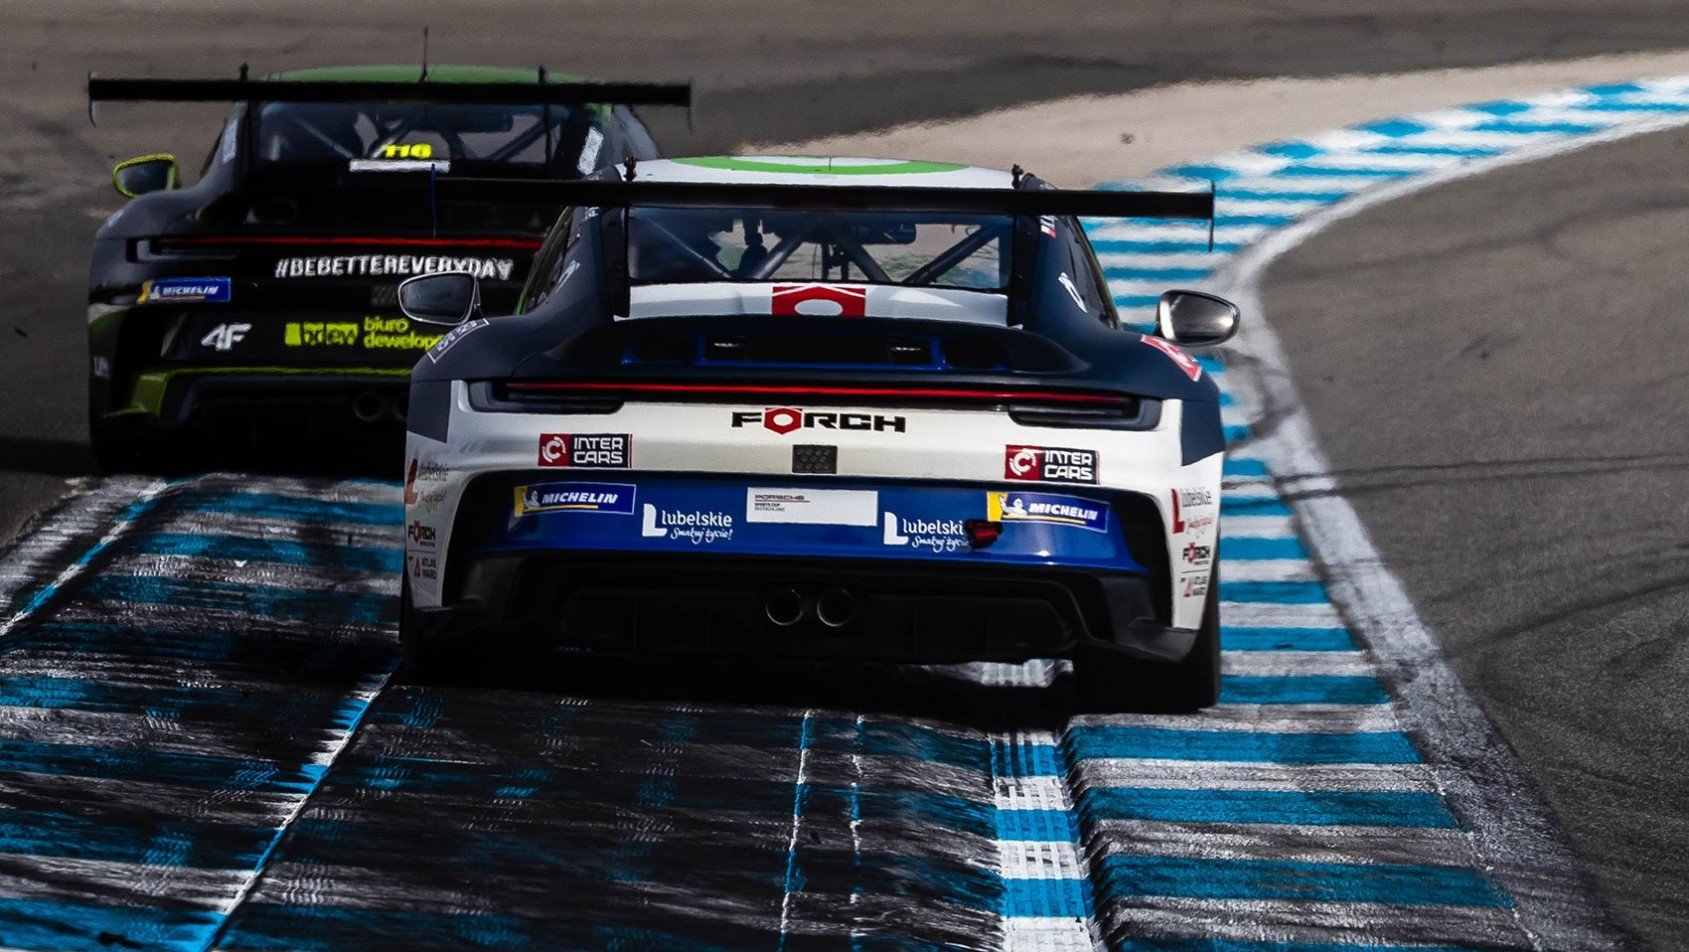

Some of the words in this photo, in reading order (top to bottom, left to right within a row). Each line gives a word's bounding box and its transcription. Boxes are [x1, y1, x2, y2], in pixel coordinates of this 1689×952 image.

[162, 285, 220, 296] MICHELIN
[363, 316, 409, 333] biuro
[573, 436, 624, 450] INTER
[573, 451, 624, 464] CARS
[1044, 450, 1093, 466] INTER
[1044, 466, 1093, 480] CARS
[541, 492, 619, 504] MICHELIN
[1028, 502, 1099, 521] MICHELIN
